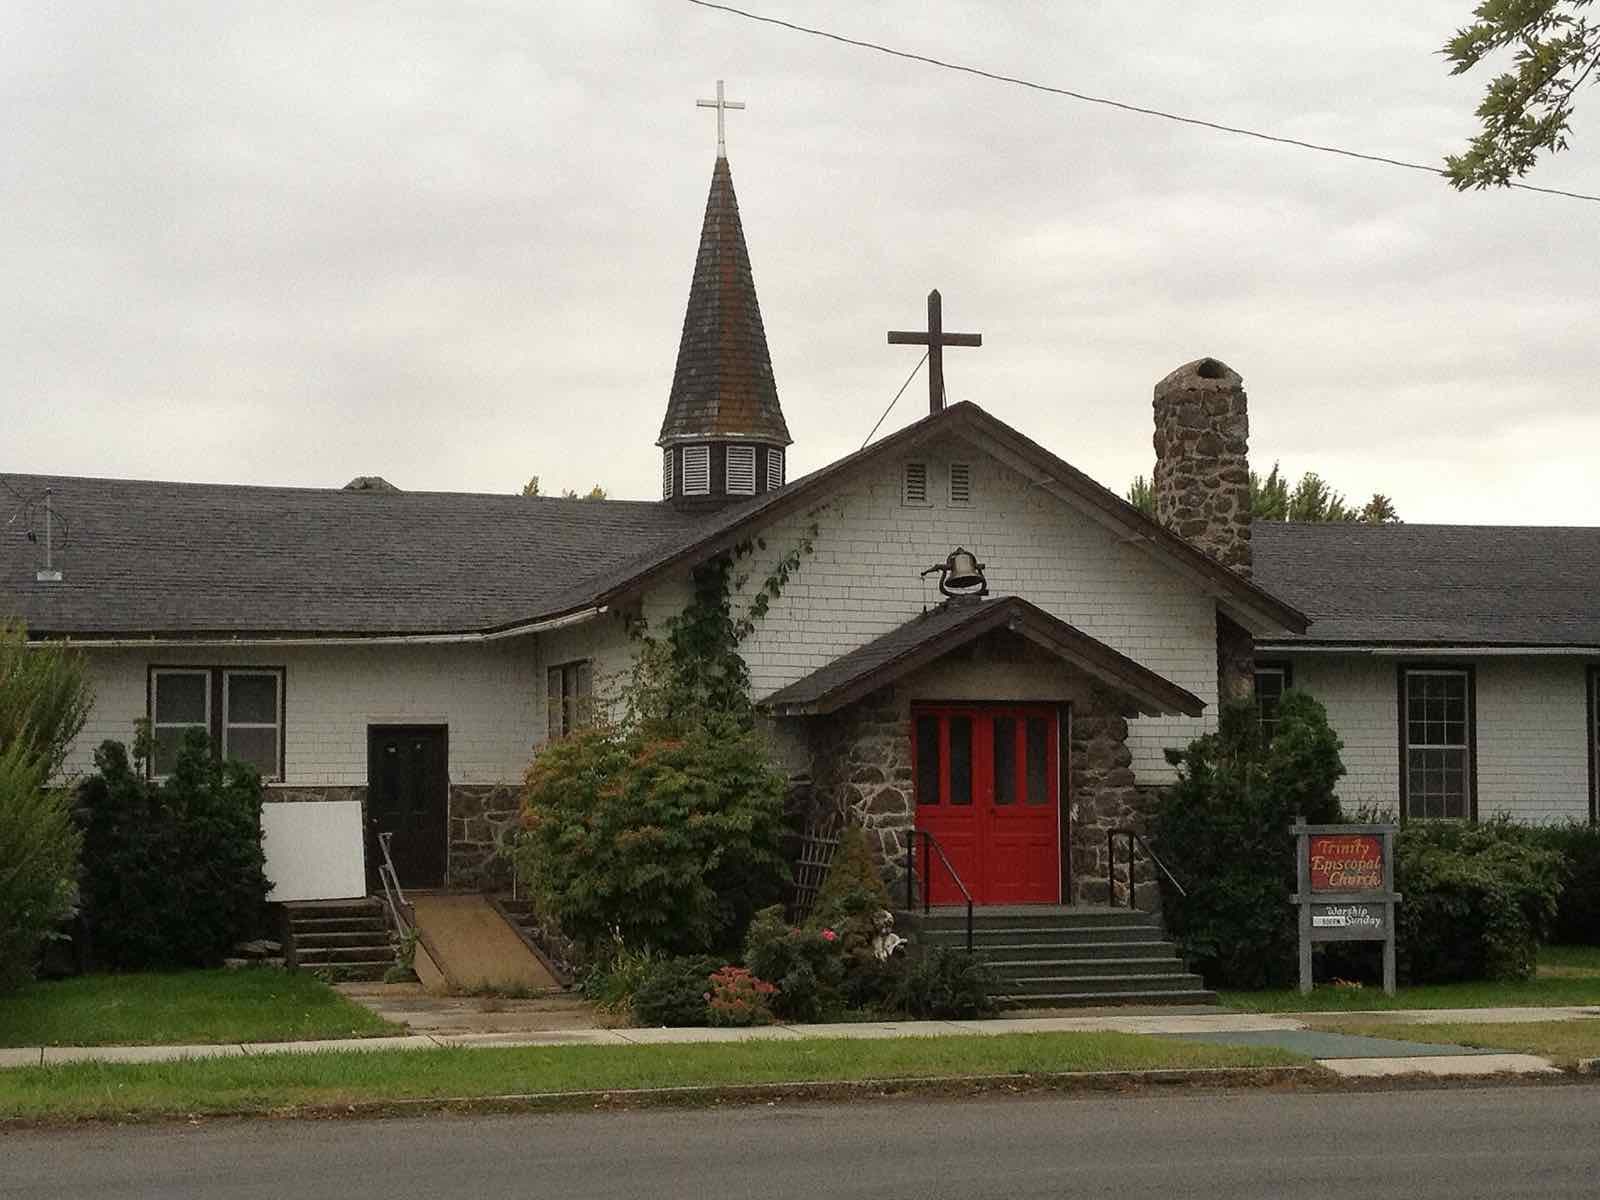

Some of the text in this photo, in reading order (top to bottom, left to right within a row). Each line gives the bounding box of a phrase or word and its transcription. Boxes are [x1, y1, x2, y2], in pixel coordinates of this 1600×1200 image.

[1318, 839, 1369, 859] Trinity
[1312, 856, 1381, 874] Episcopal
[1329, 871, 1381, 886] Church
[1325, 906, 1368, 917] Worship
[1345, 914, 1381, 928] Sunday
